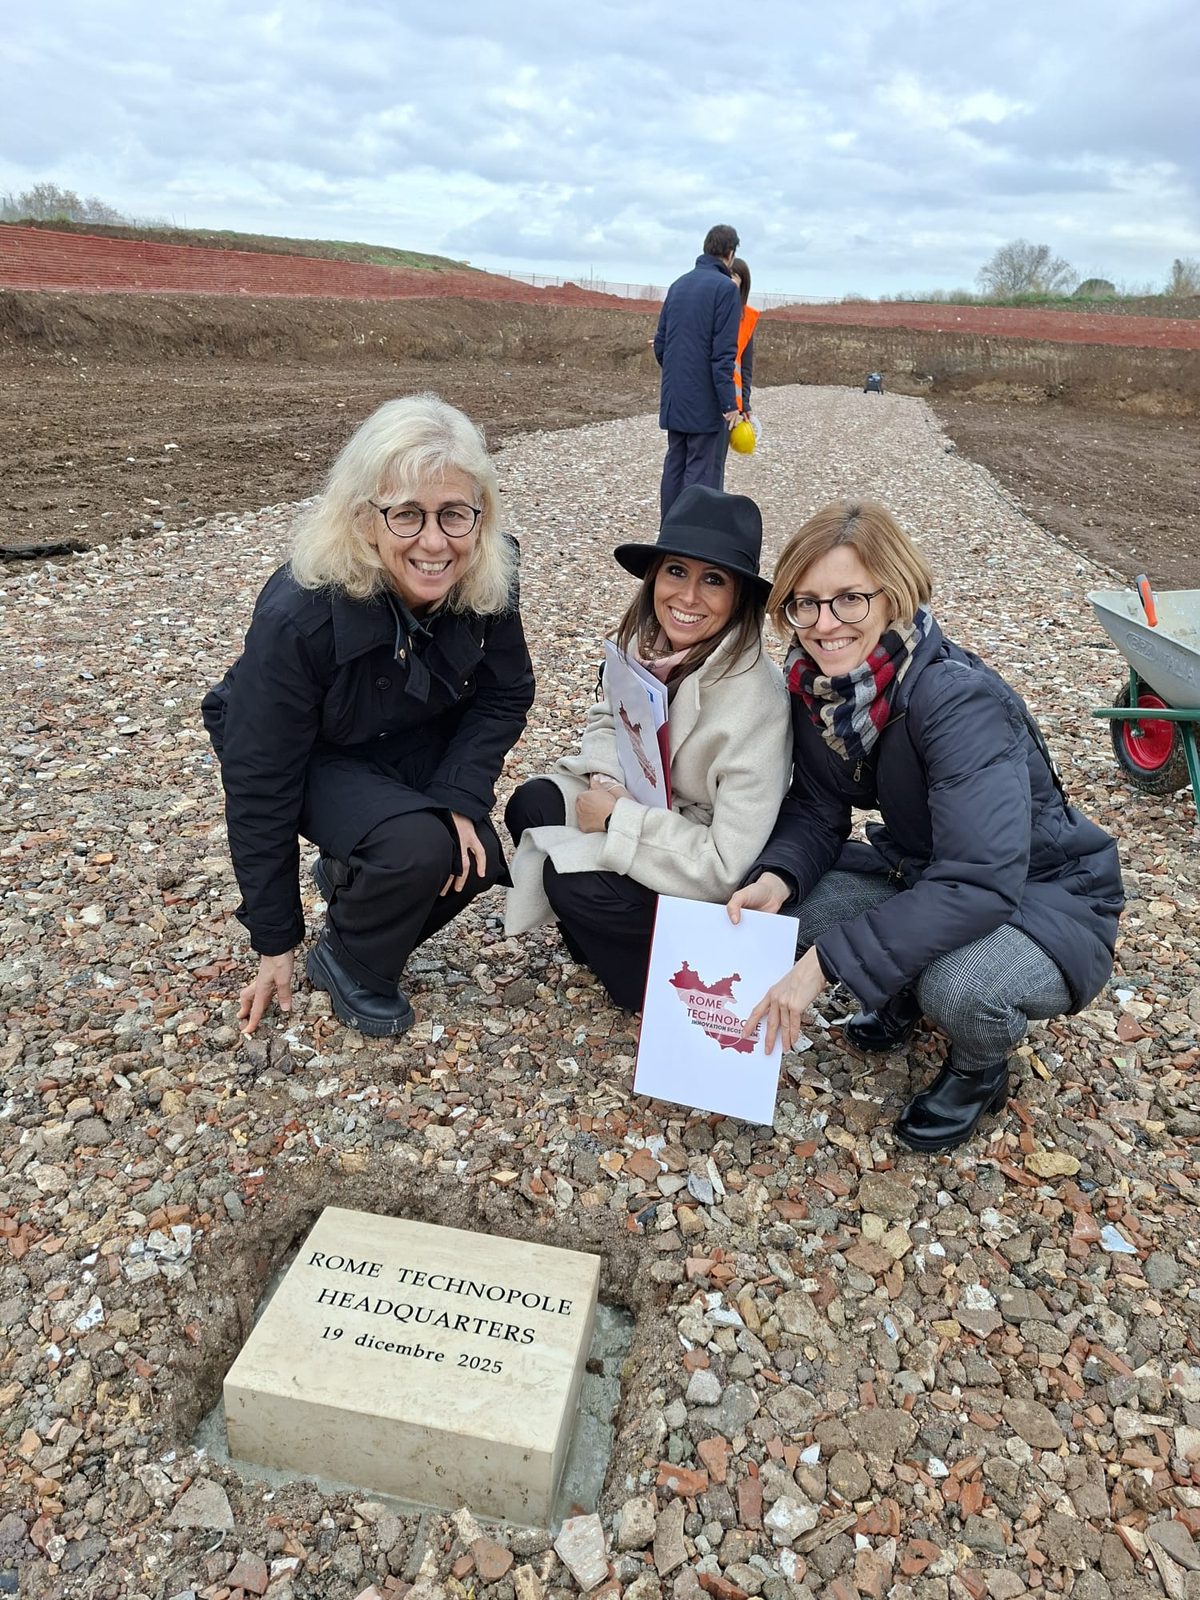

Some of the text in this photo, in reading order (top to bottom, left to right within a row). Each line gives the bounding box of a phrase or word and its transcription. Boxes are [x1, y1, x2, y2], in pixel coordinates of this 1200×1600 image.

[687, 1007, 762, 1032] TECHNOPOE
[688, 994, 722, 1010] ROME
[691, 1019, 727, 1032] INNOVATION
[308, 1252, 573, 1316] ROME TECHNOPOLE
[315, 1288, 536, 1345] HEADQUARTERS
[319, 1326, 503, 1375] 19 dicembre 2025
